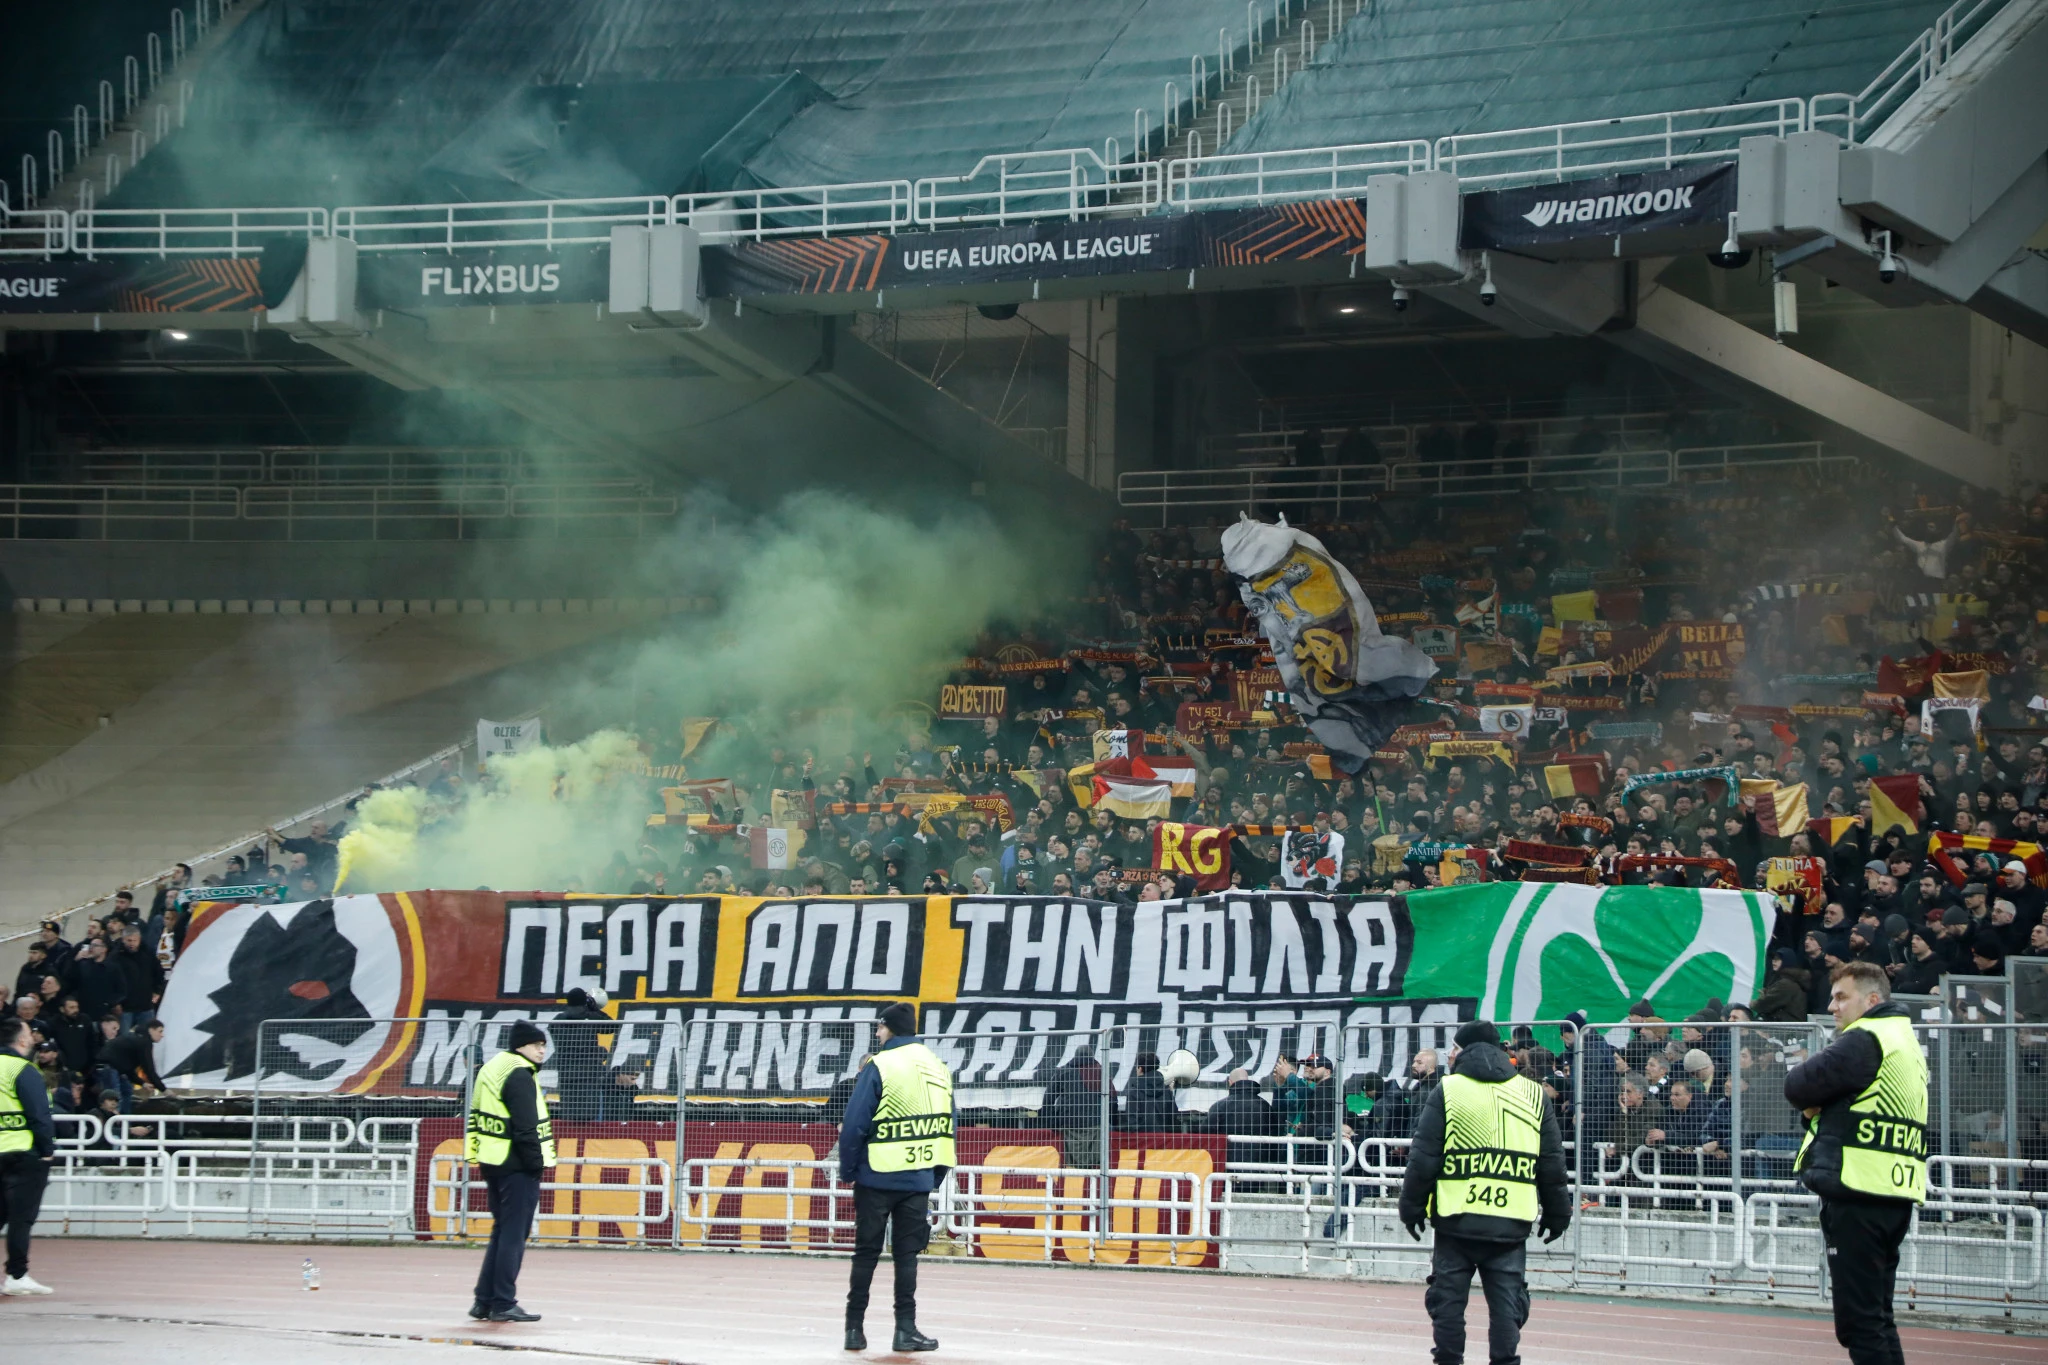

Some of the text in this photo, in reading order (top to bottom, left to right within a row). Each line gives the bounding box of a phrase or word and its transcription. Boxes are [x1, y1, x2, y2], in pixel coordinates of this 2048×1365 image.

[903, 246, 962, 271] UEFA
[967, 239, 1057, 266] EUROPA
[1680, 624, 1745, 643] BELLA
[494, 726, 521, 738] OLTRE
[1160, 823, 1222, 877] RG
[1775, 857, 1813, 871] ROMA
[502, 901, 704, 995] ΠΕΡΑ
[742, 902, 910, 993] ΑΠΟ
[955, 902, 1117, 994] ΤΗΝ
[905, 1144, 934, 1164] 315
[1466, 1184, 1508, 1208] 348
